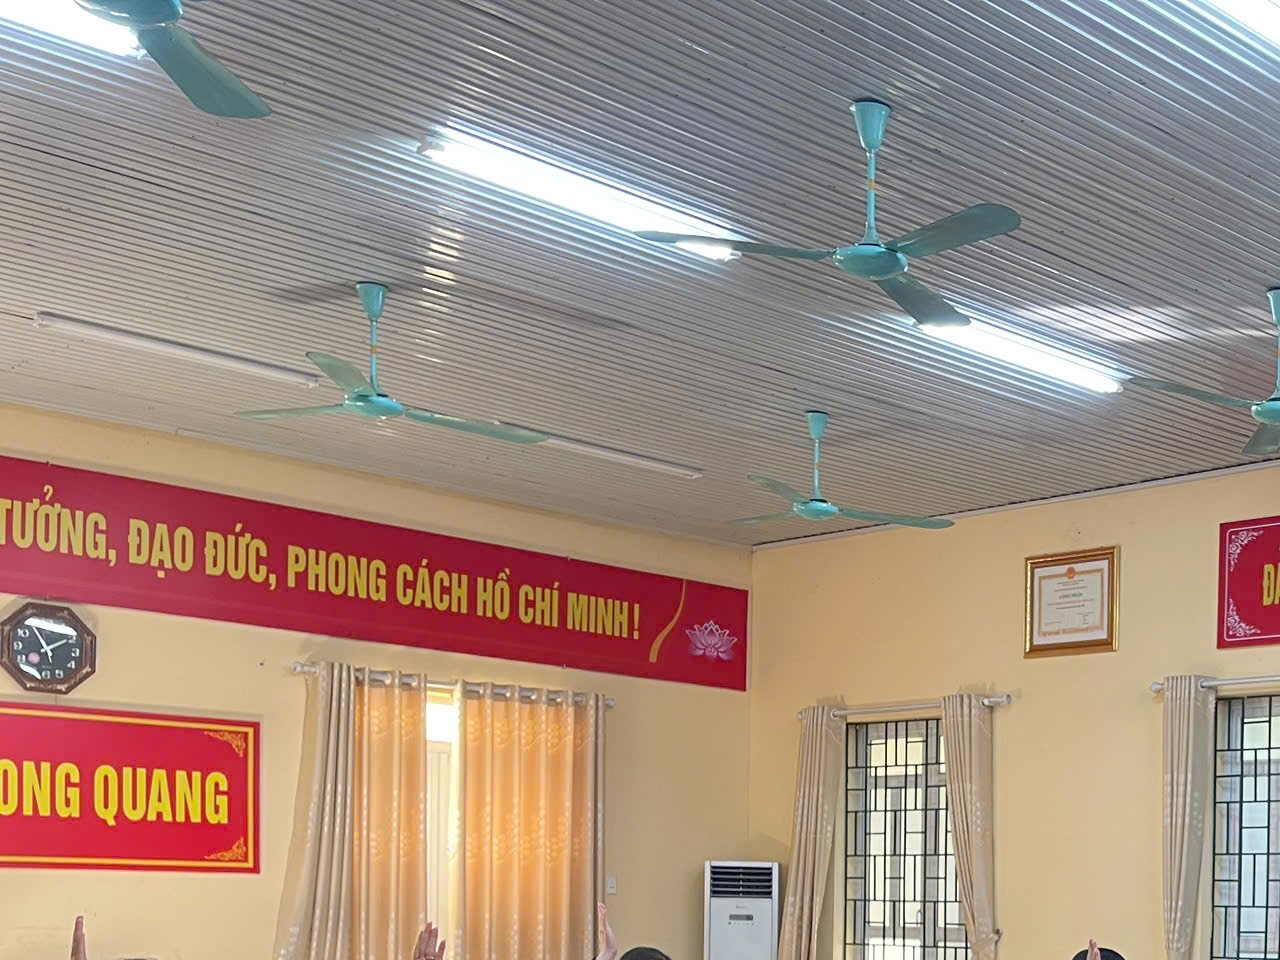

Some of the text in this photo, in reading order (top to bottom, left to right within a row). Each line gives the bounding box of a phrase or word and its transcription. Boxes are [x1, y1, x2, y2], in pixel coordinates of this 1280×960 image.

[0, 484, 117, 567] TƯỞNG,
[128, 518, 194, 580] ĐẠO
[205, 529, 277, 590] ĐỨC,
[287, 545, 386, 602] PHONG
[396, 548, 468, 613] CÁCH
[476, 567, 511, 621] HỒ
[518, 581, 560, 627] CHÍ
[94, 764, 229, 826] QUANG
